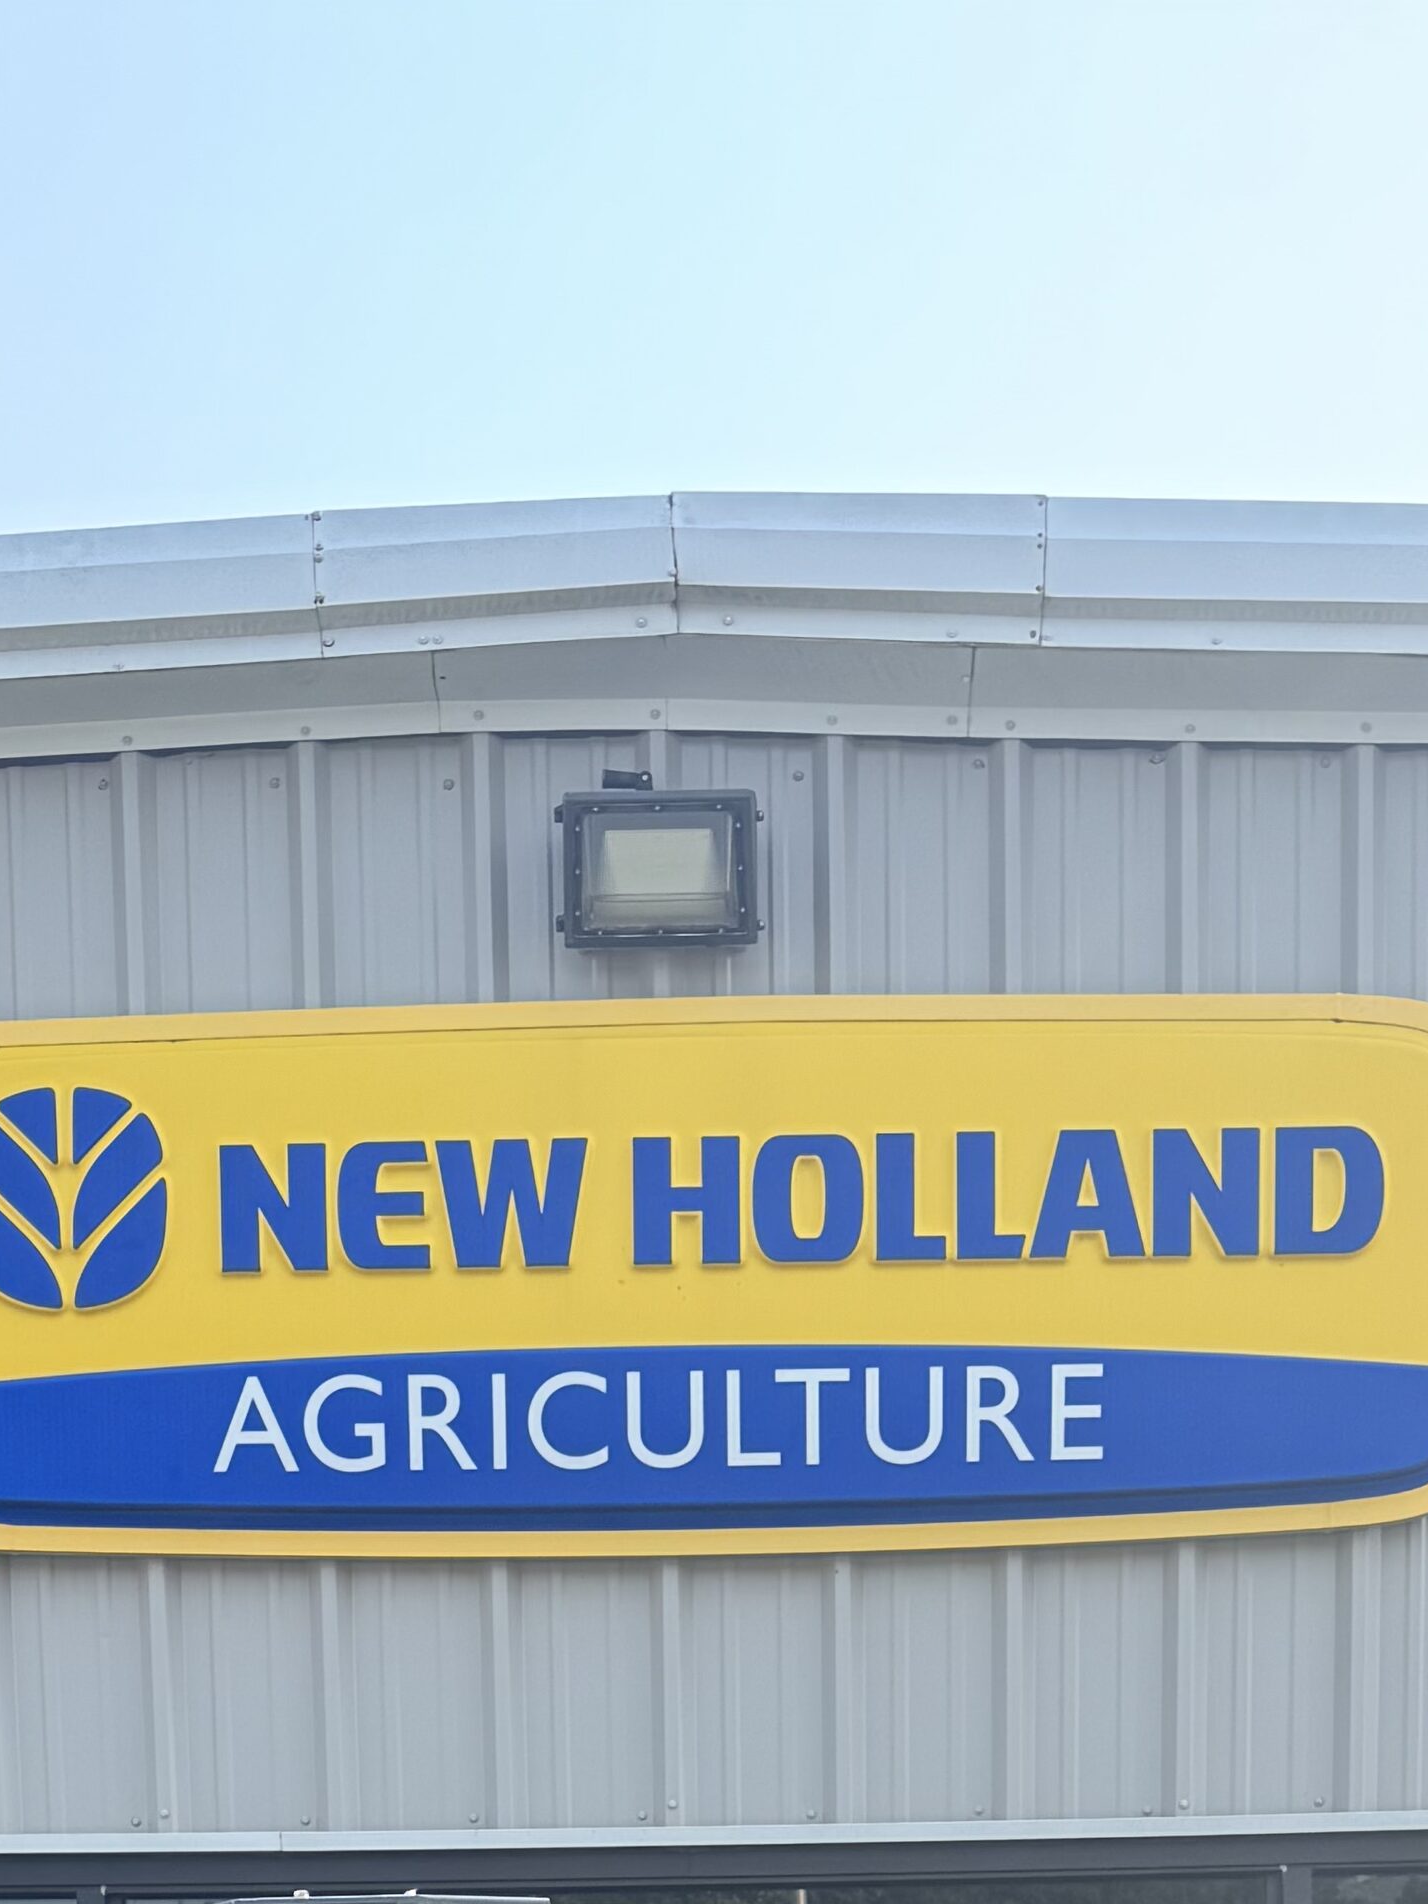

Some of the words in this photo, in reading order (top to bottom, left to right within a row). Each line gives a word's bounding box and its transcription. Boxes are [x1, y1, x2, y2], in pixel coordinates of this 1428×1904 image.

[219, 1137, 588, 1273] NEW
[632, 1126, 1385, 1266] HOLLAND
[213, 1362, 1104, 1474] AGRICULTURE
